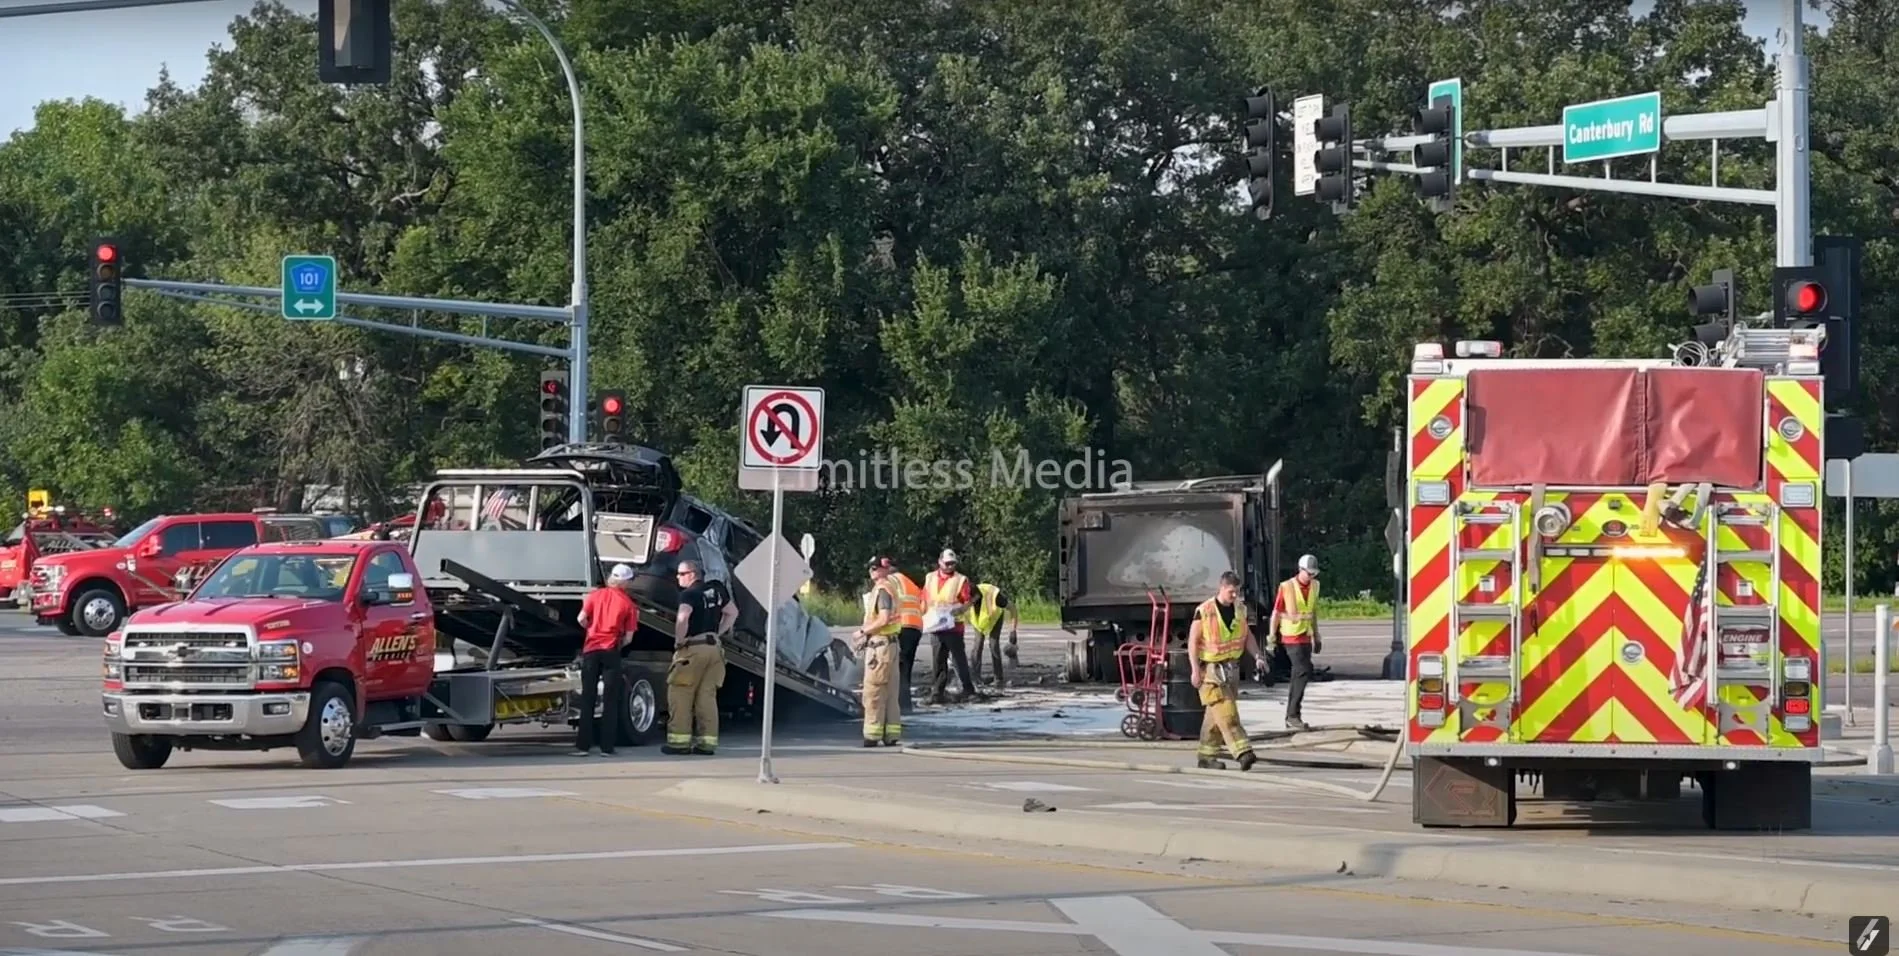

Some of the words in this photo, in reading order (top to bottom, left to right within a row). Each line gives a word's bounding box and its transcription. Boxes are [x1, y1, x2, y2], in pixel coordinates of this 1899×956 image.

[1569, 118, 1634, 144] Canterbury
[1639, 112, 1654, 134] Rd
[300, 272, 319, 285] 101
[1723, 634, 1763, 642] ENGINE
[1738, 644, 1746, 653] 2
